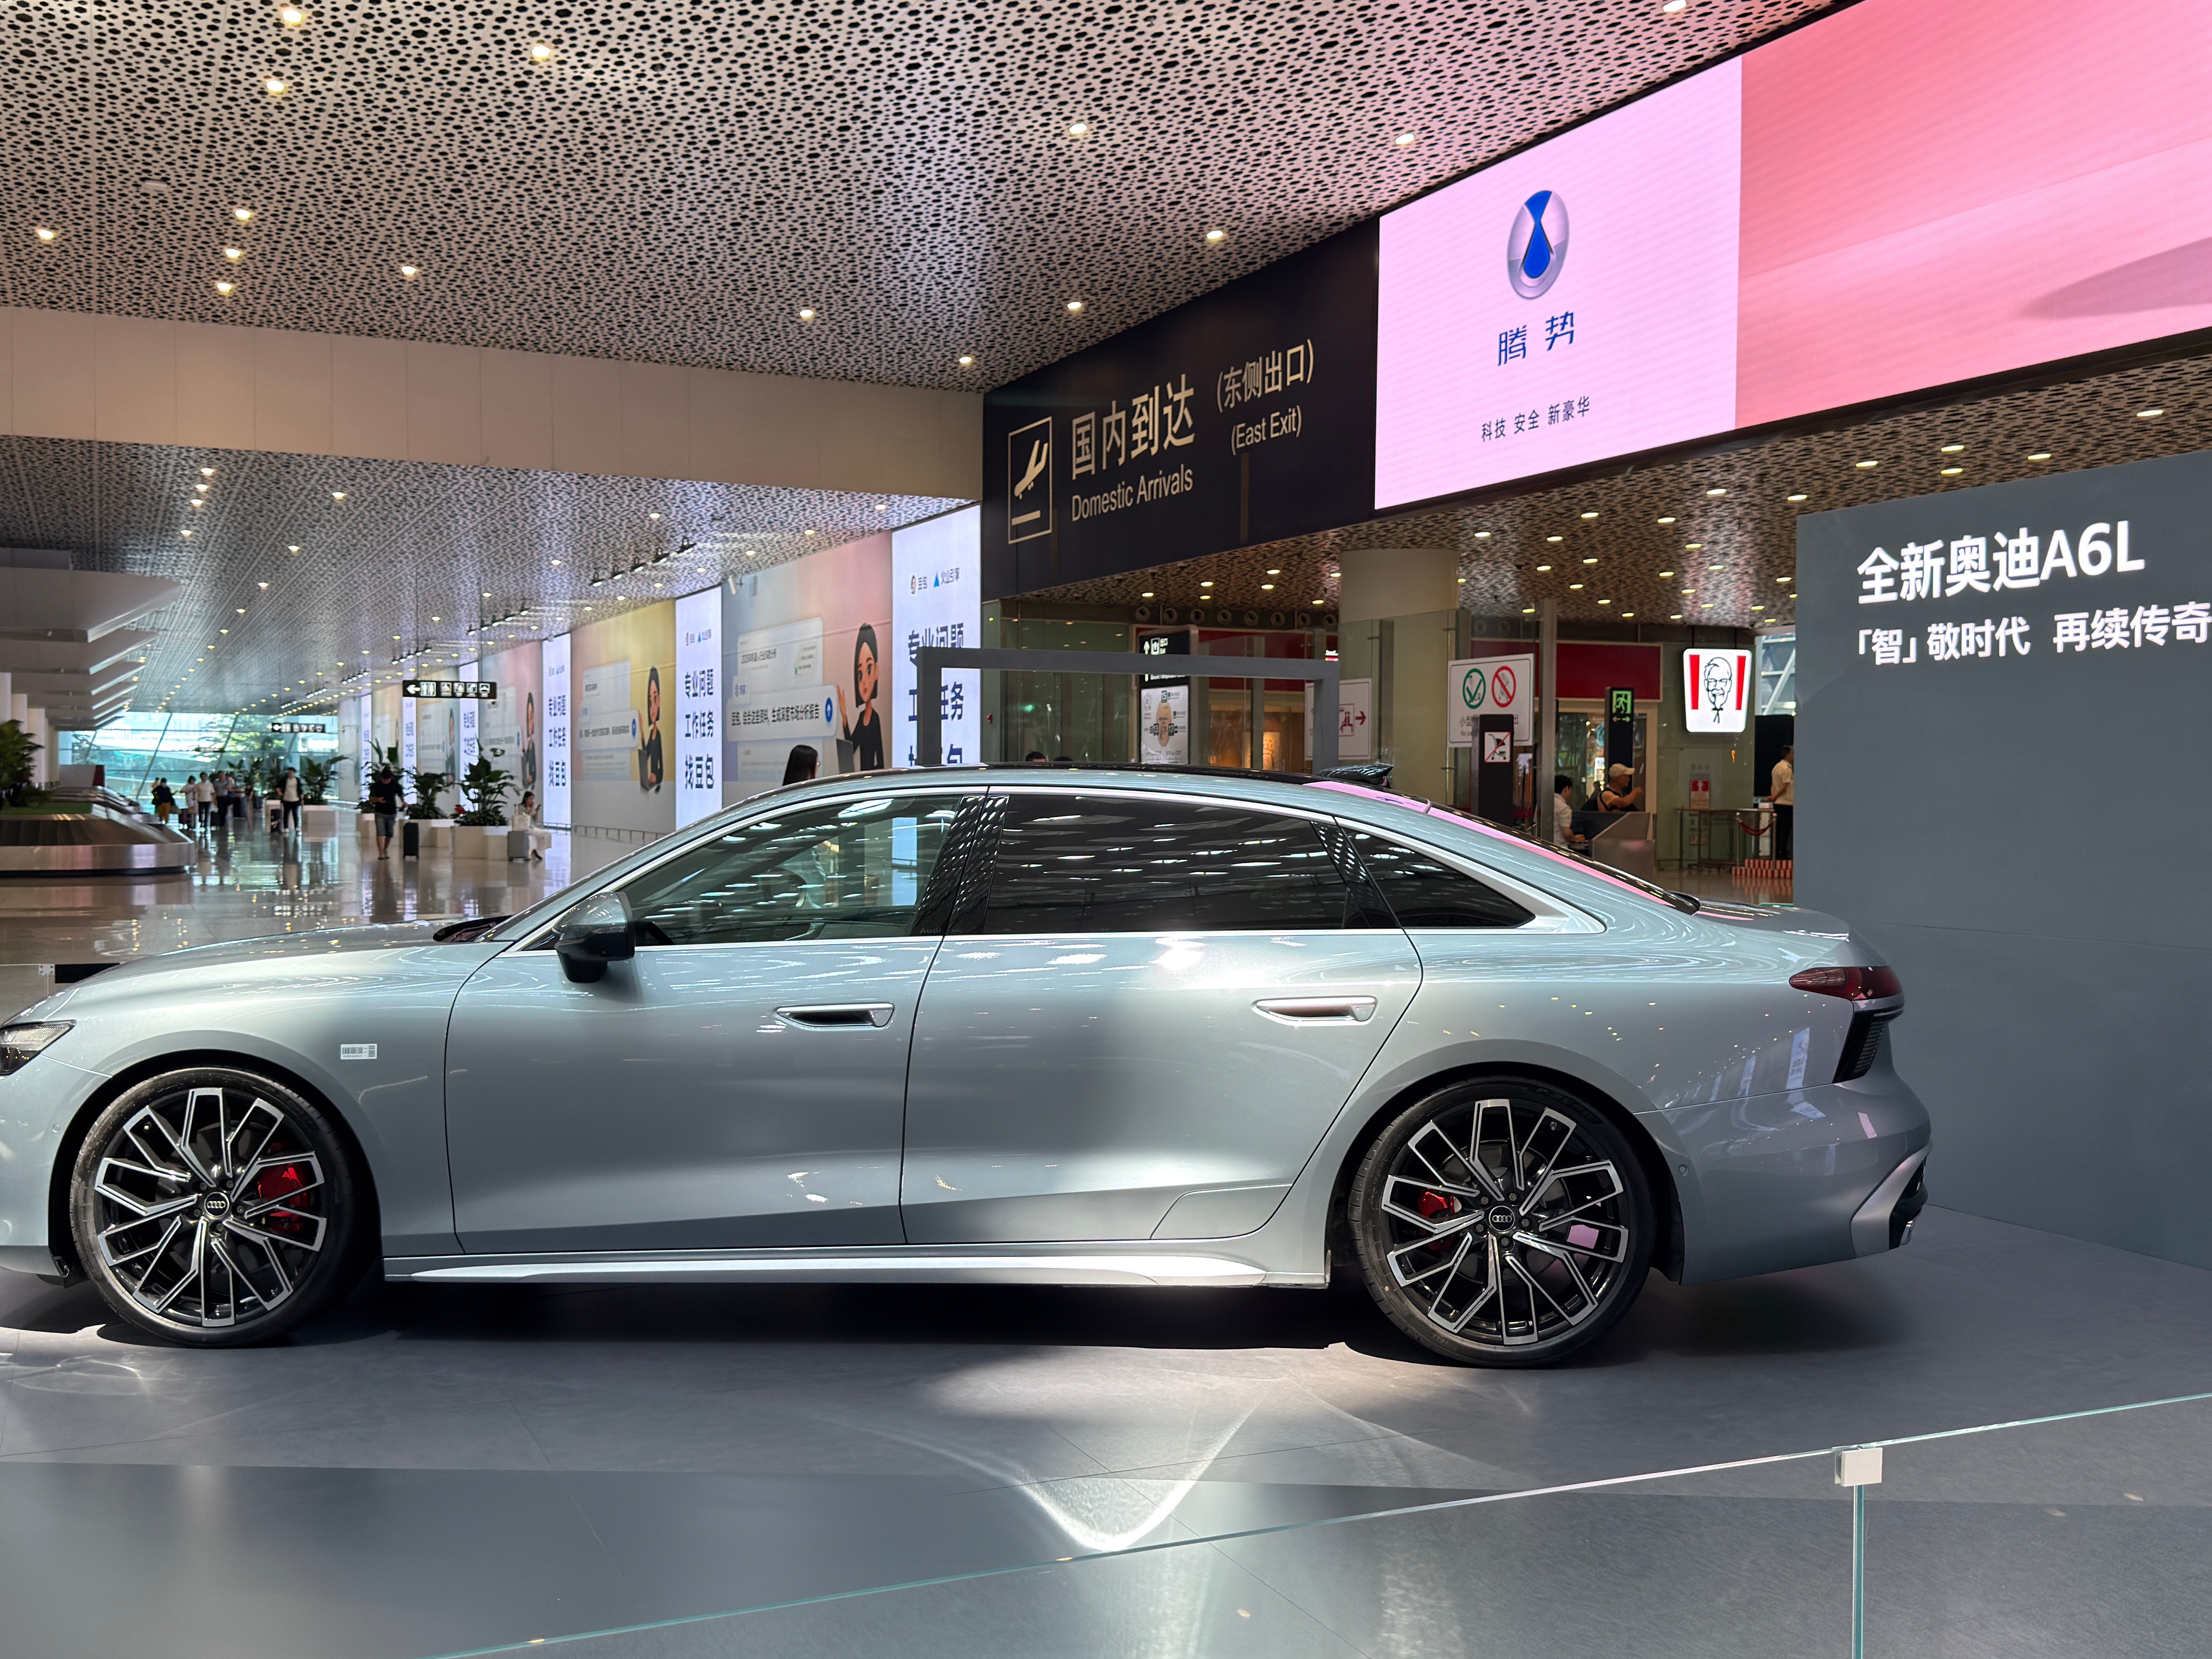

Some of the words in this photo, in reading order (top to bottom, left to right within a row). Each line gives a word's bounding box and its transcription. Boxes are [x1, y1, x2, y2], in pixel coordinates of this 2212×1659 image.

[1498, 311, 1575, 366] 腾势
[1072, 374, 1195, 480] 国内到达
[1231, 419, 1266, 455] (East
[1270, 405, 1302, 438] Exit)
[1481, 418, 1506, 442] 科技
[1514, 409, 1539, 434] 安全
[1548, 396, 1590, 425] 新豪华
[1072, 482, 1133, 522] Domestic
[1137, 464, 1193, 504] Arrivals
[1857, 520, 2145, 604] 全新奥迪A6L
[2053, 601, 2212, 653] 再续传奇
[685, 668, 713, 699] 专业问题
[685, 709, 713, 739] 工作任务
[685, 754, 714, 789] 找豆包
